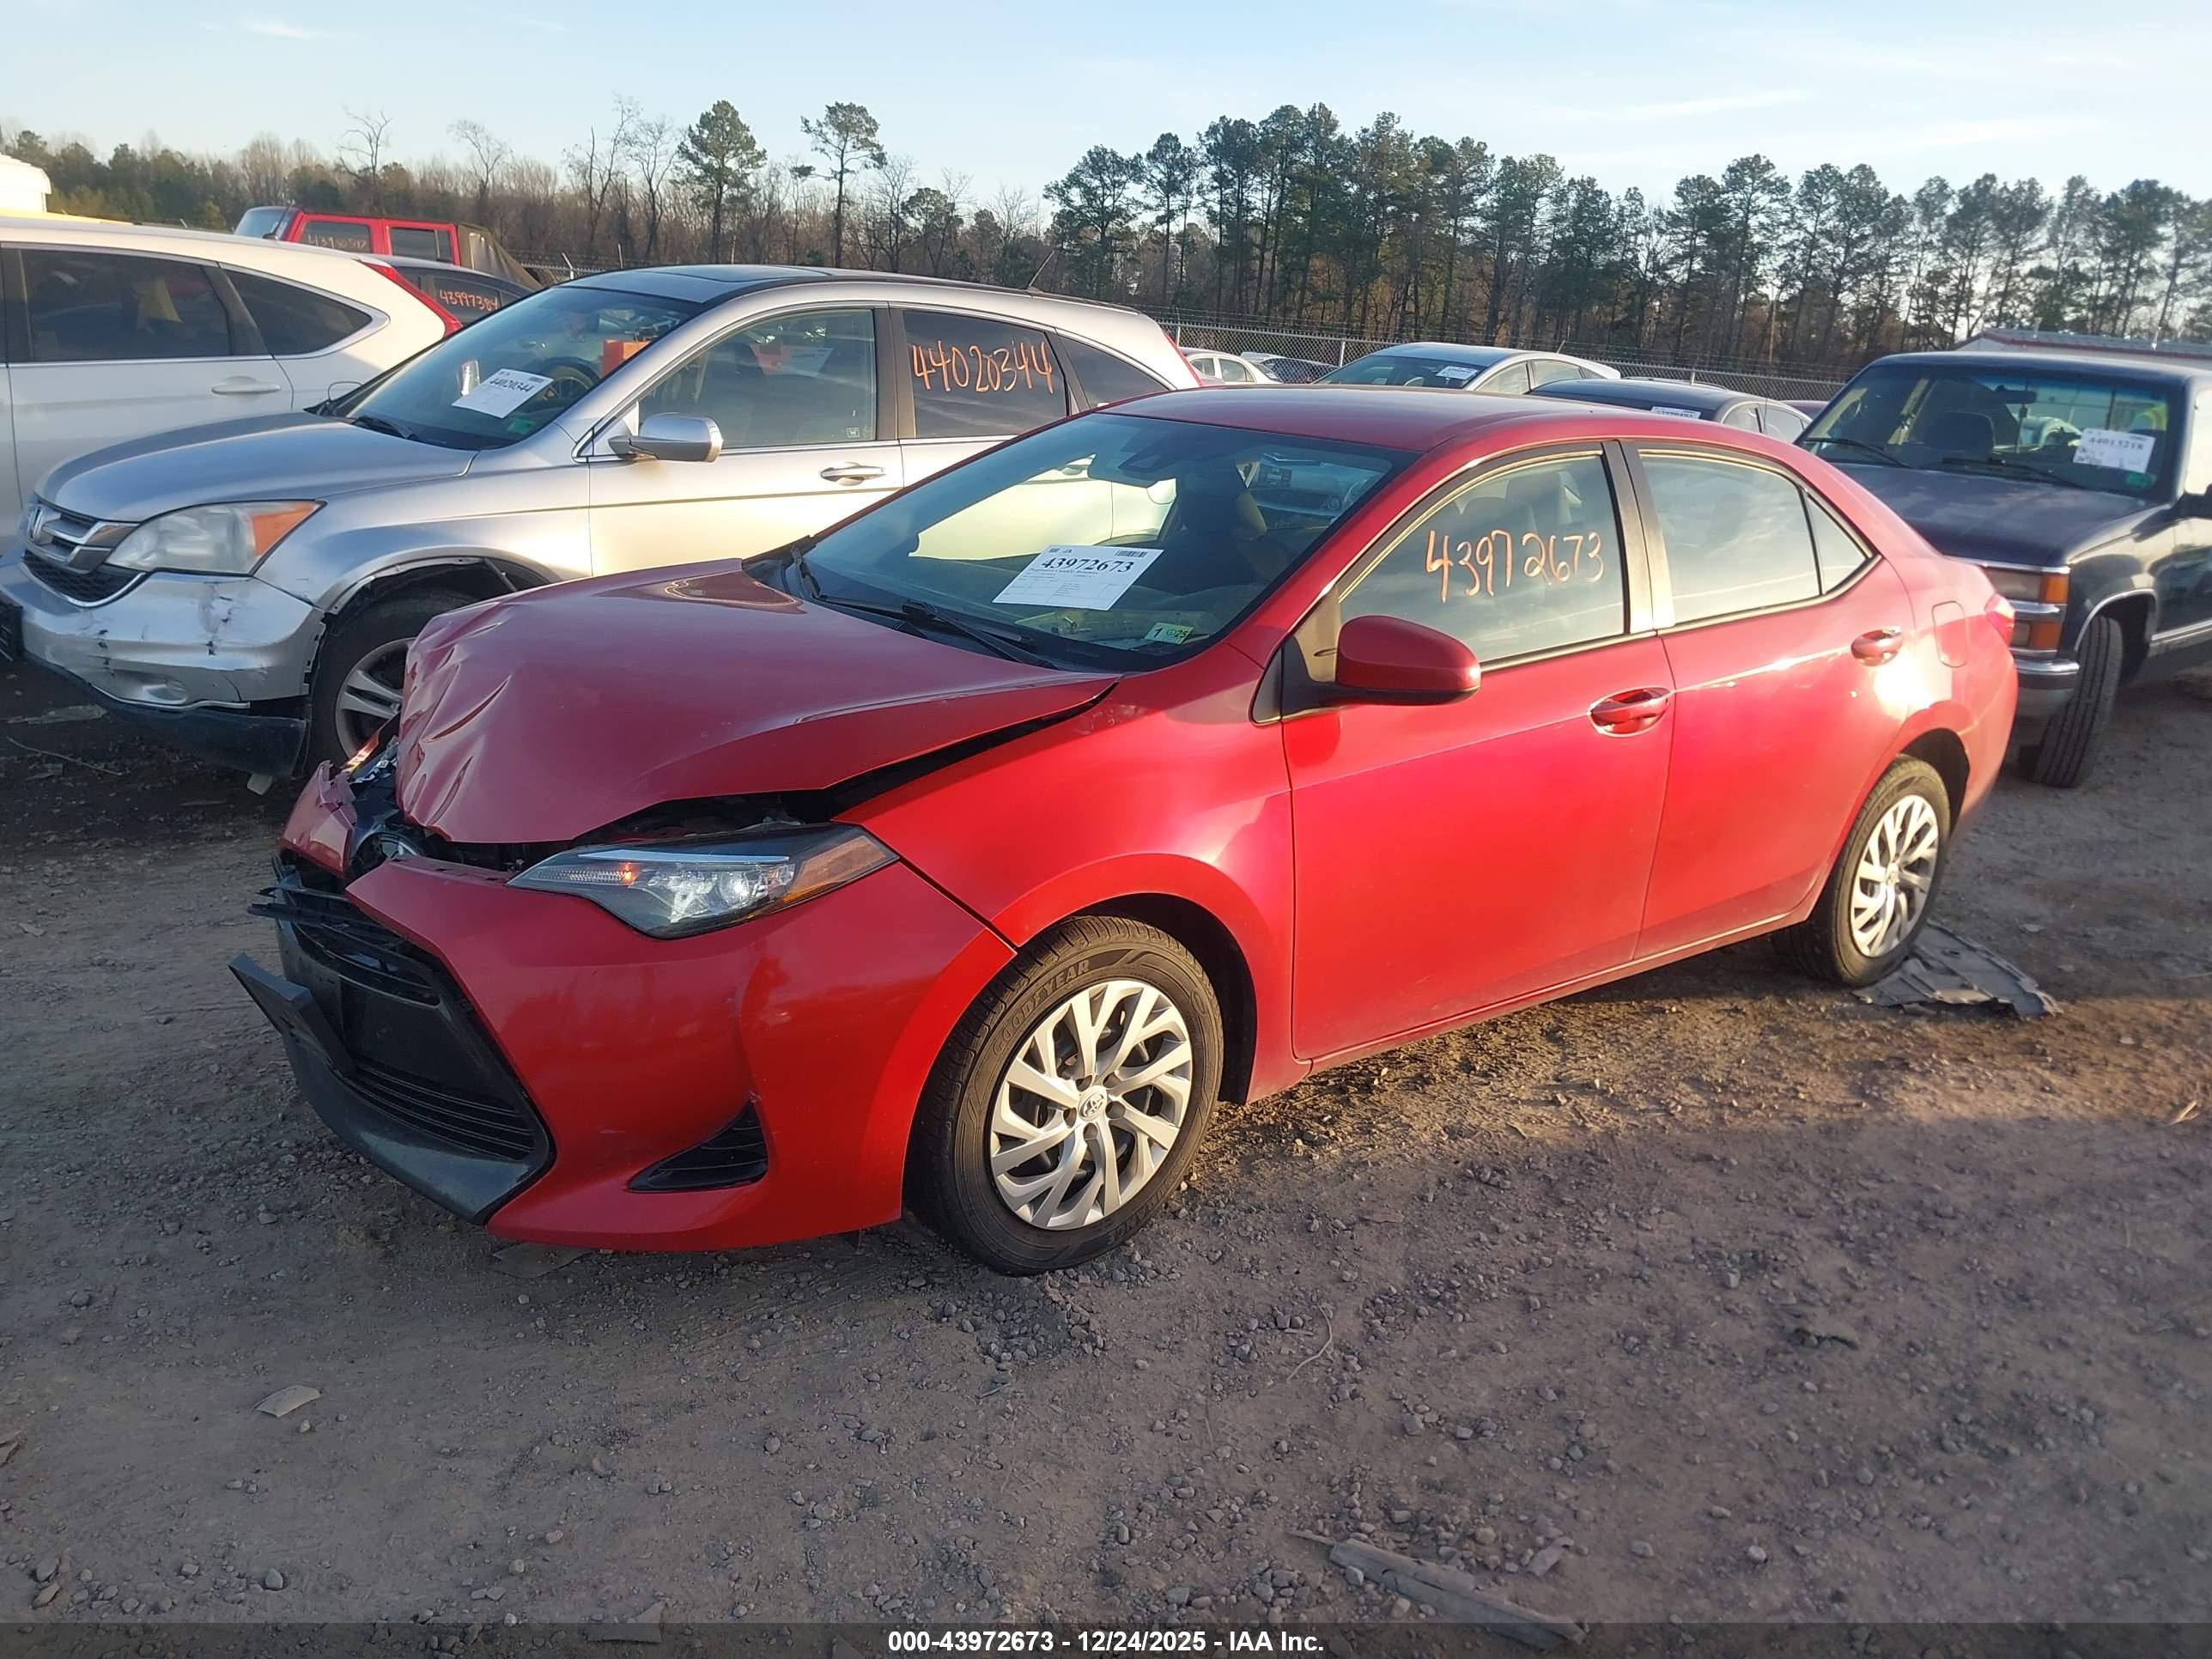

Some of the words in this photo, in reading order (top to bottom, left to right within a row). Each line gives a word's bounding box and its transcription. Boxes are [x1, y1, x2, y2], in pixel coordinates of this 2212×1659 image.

[439, 289, 498, 311] 43997384
[912, 340, 1054, 394] 44020344
[1042, 556, 1134, 573] 43972673
[1425, 529, 1605, 605] 43972673
[1154, 627, 1163, 638] 1
[1174, 629, 1189, 639] 25
